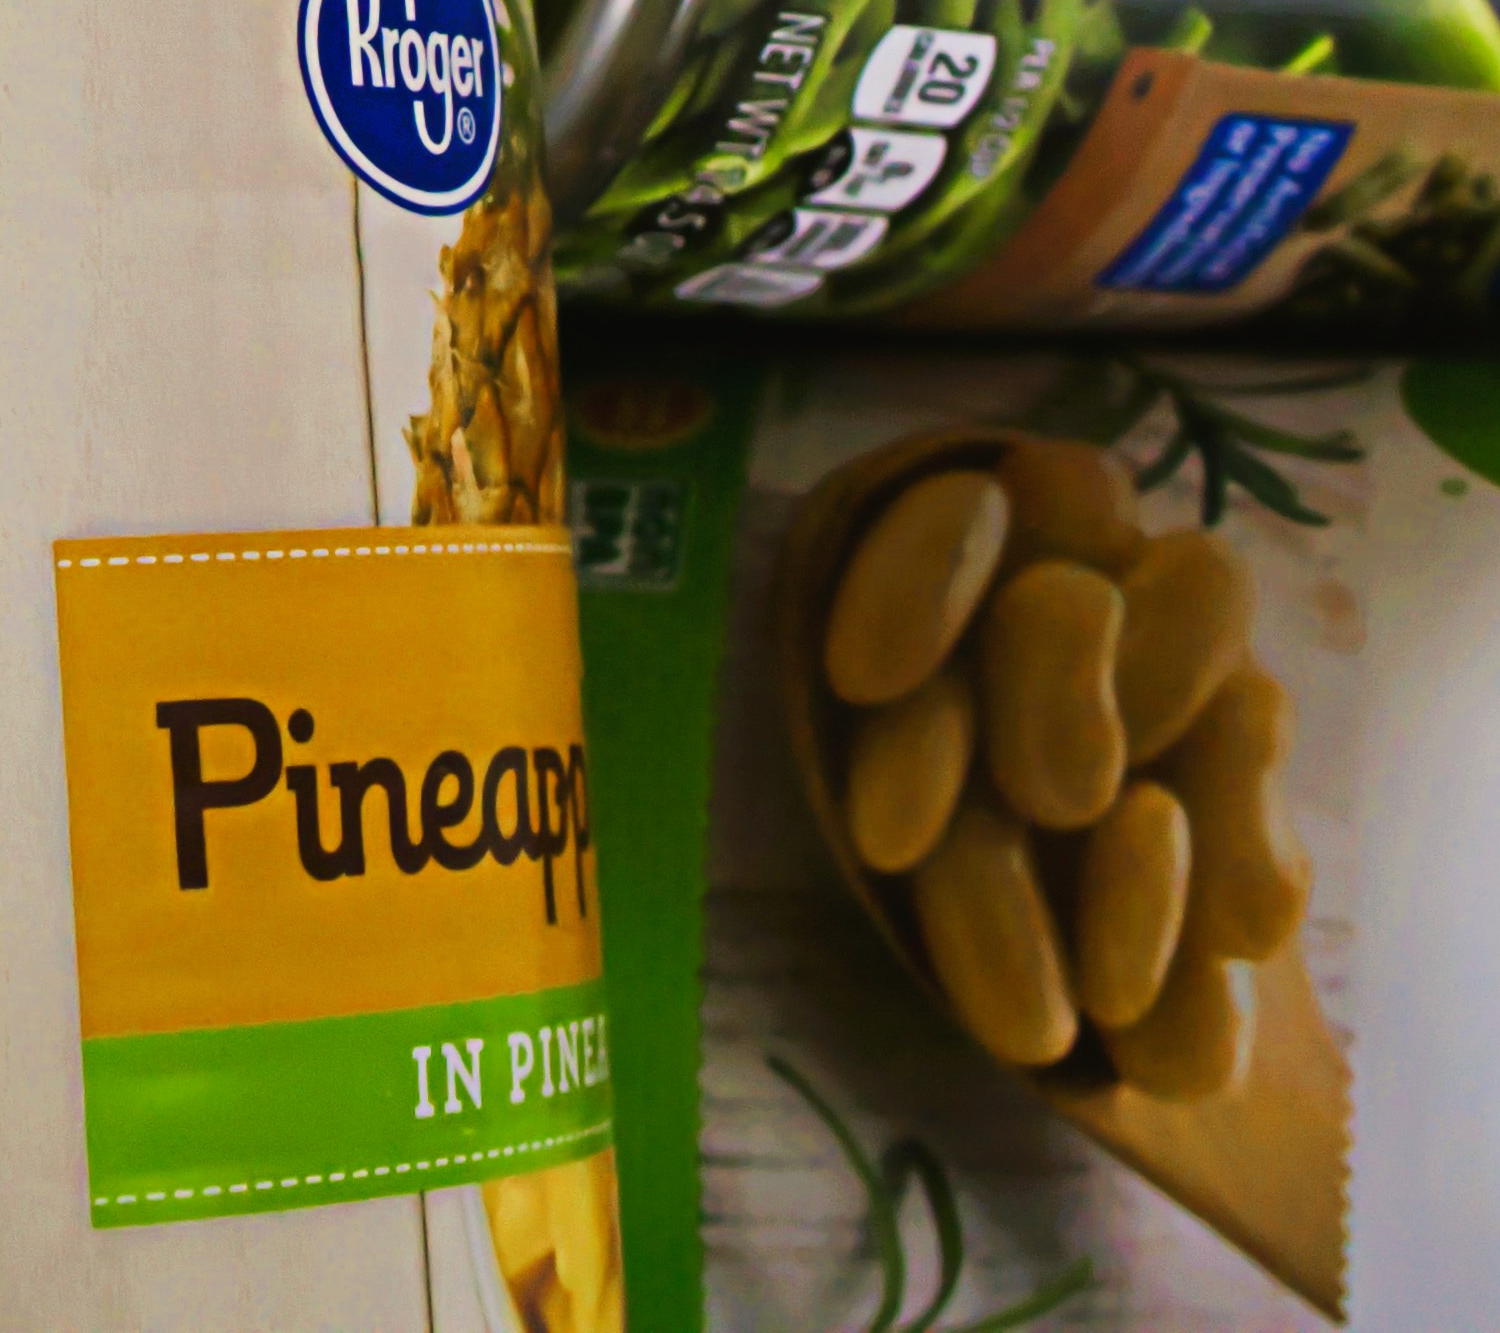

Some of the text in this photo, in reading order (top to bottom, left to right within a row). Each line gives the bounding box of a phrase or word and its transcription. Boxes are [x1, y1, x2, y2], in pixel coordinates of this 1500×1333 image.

[713, 12, 827, 160] NET WT
[917, 52, 981, 108] 20
[411, 1037, 486, 1119] IN
